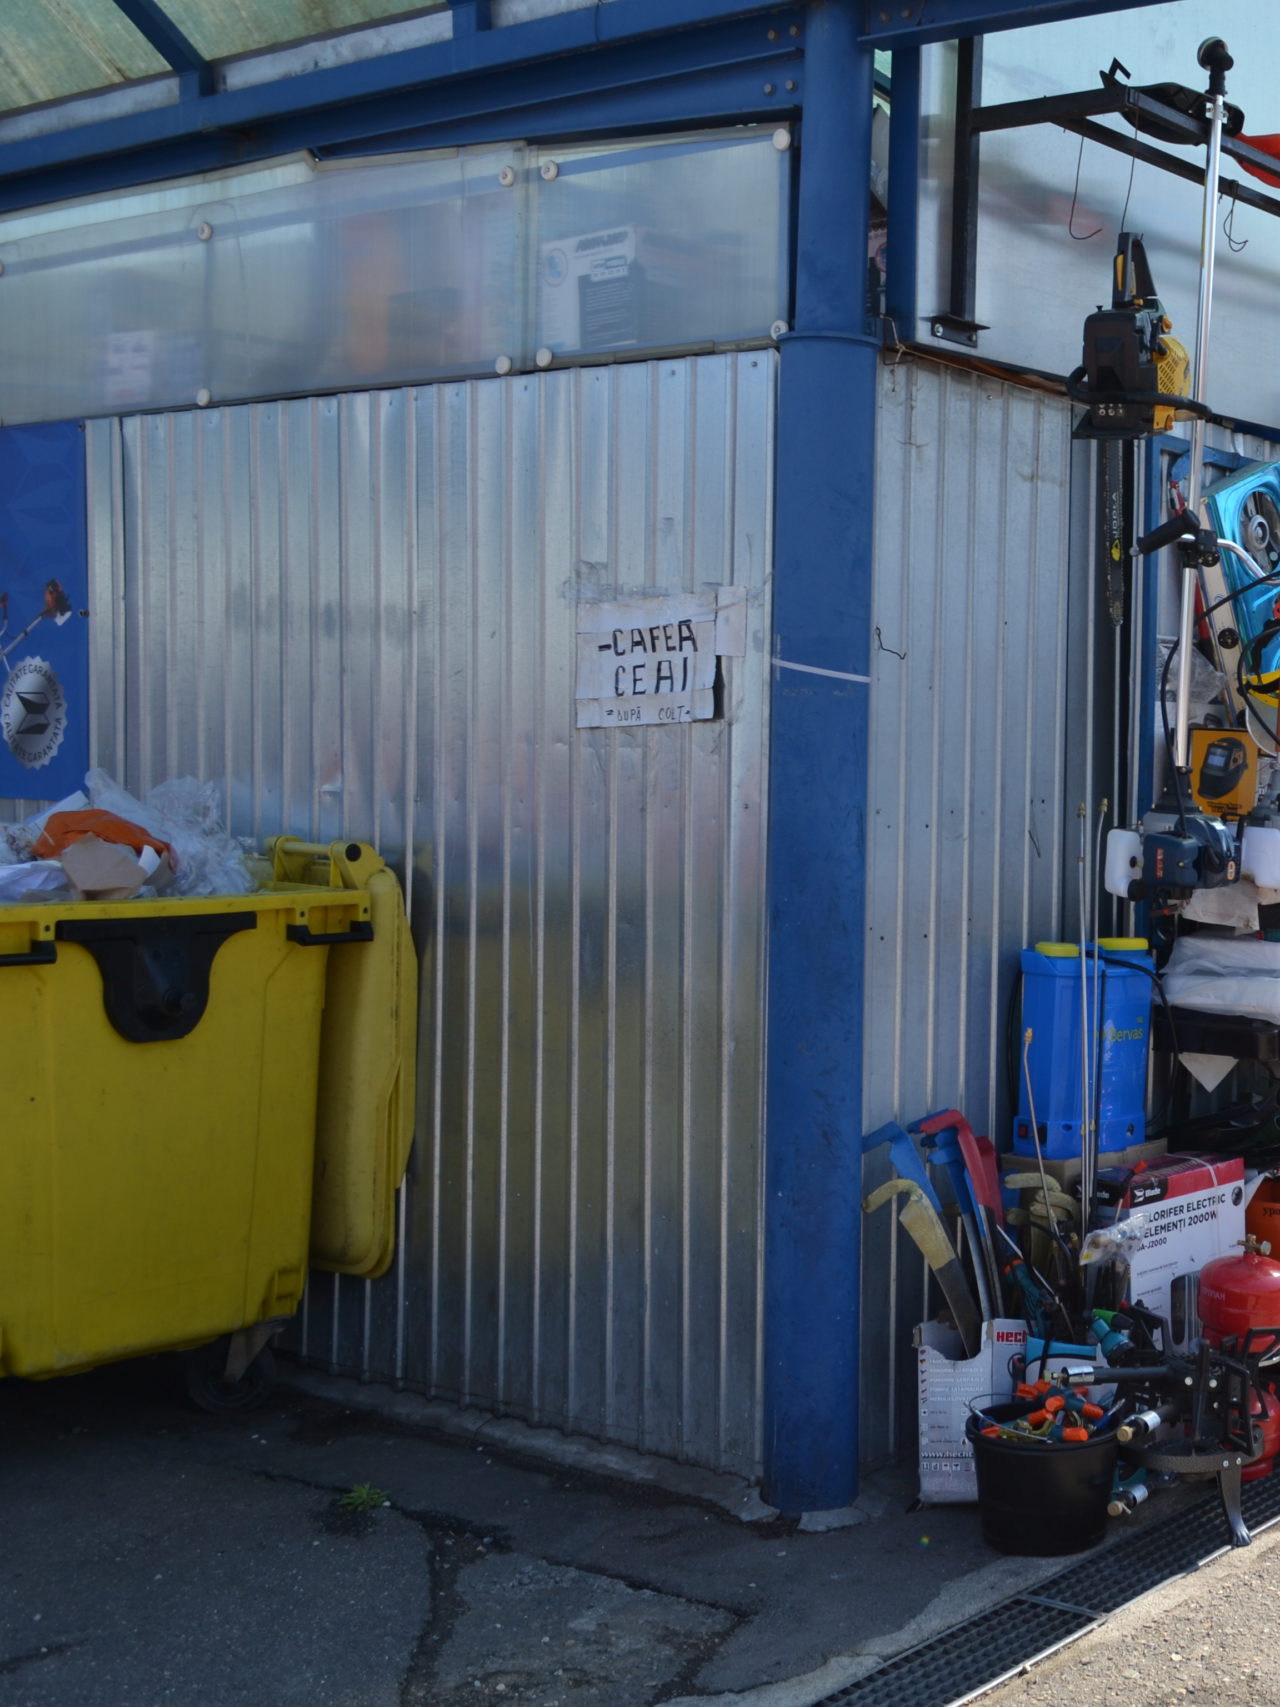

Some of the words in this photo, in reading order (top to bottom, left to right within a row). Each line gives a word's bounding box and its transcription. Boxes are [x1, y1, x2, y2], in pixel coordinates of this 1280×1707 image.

[614, 656, 688, 697] CEAI
[1148, 1207, 1184, 1223] LORIFER
[1186, 1194, 1226, 1213] ELECTRIC
[1188, 1212, 1217, 1226] 2000W
